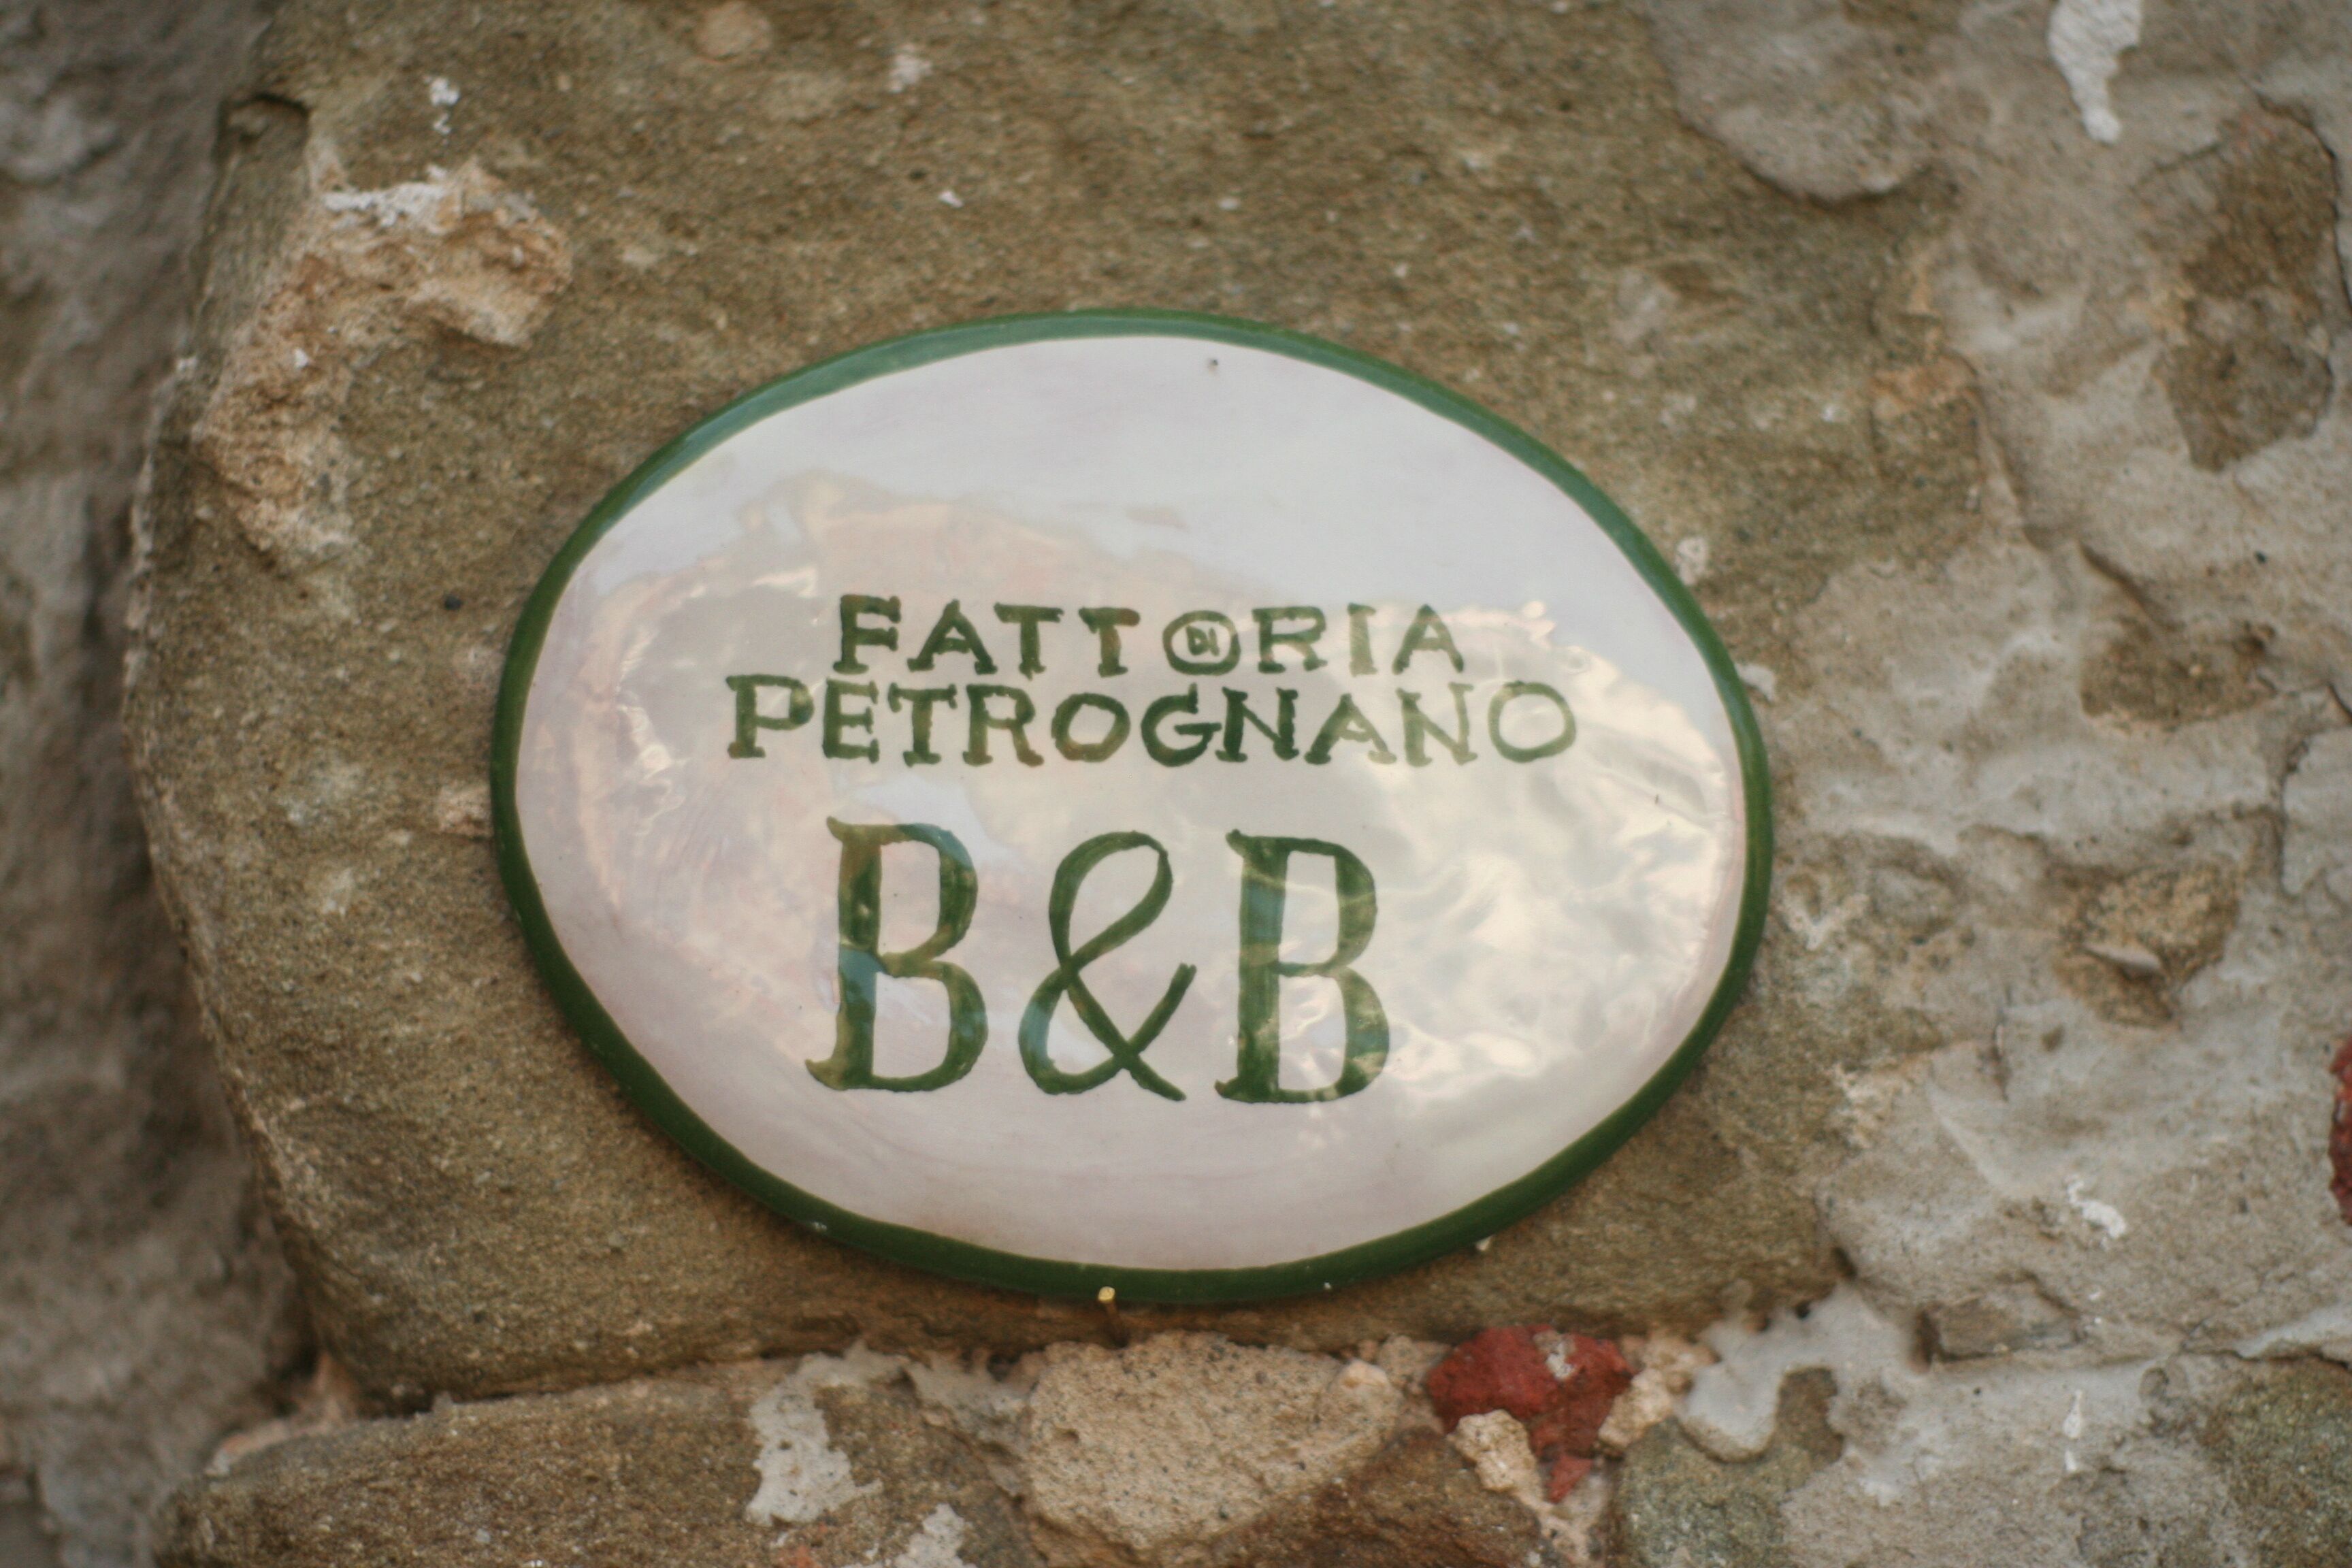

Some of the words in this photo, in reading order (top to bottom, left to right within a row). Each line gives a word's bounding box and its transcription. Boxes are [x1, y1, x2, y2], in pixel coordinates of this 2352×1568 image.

[832, 593, 1465, 679] FATTORIA
[725, 674, 1577, 767] PETROGNANO
[804, 816, 1390, 1104] B&B
